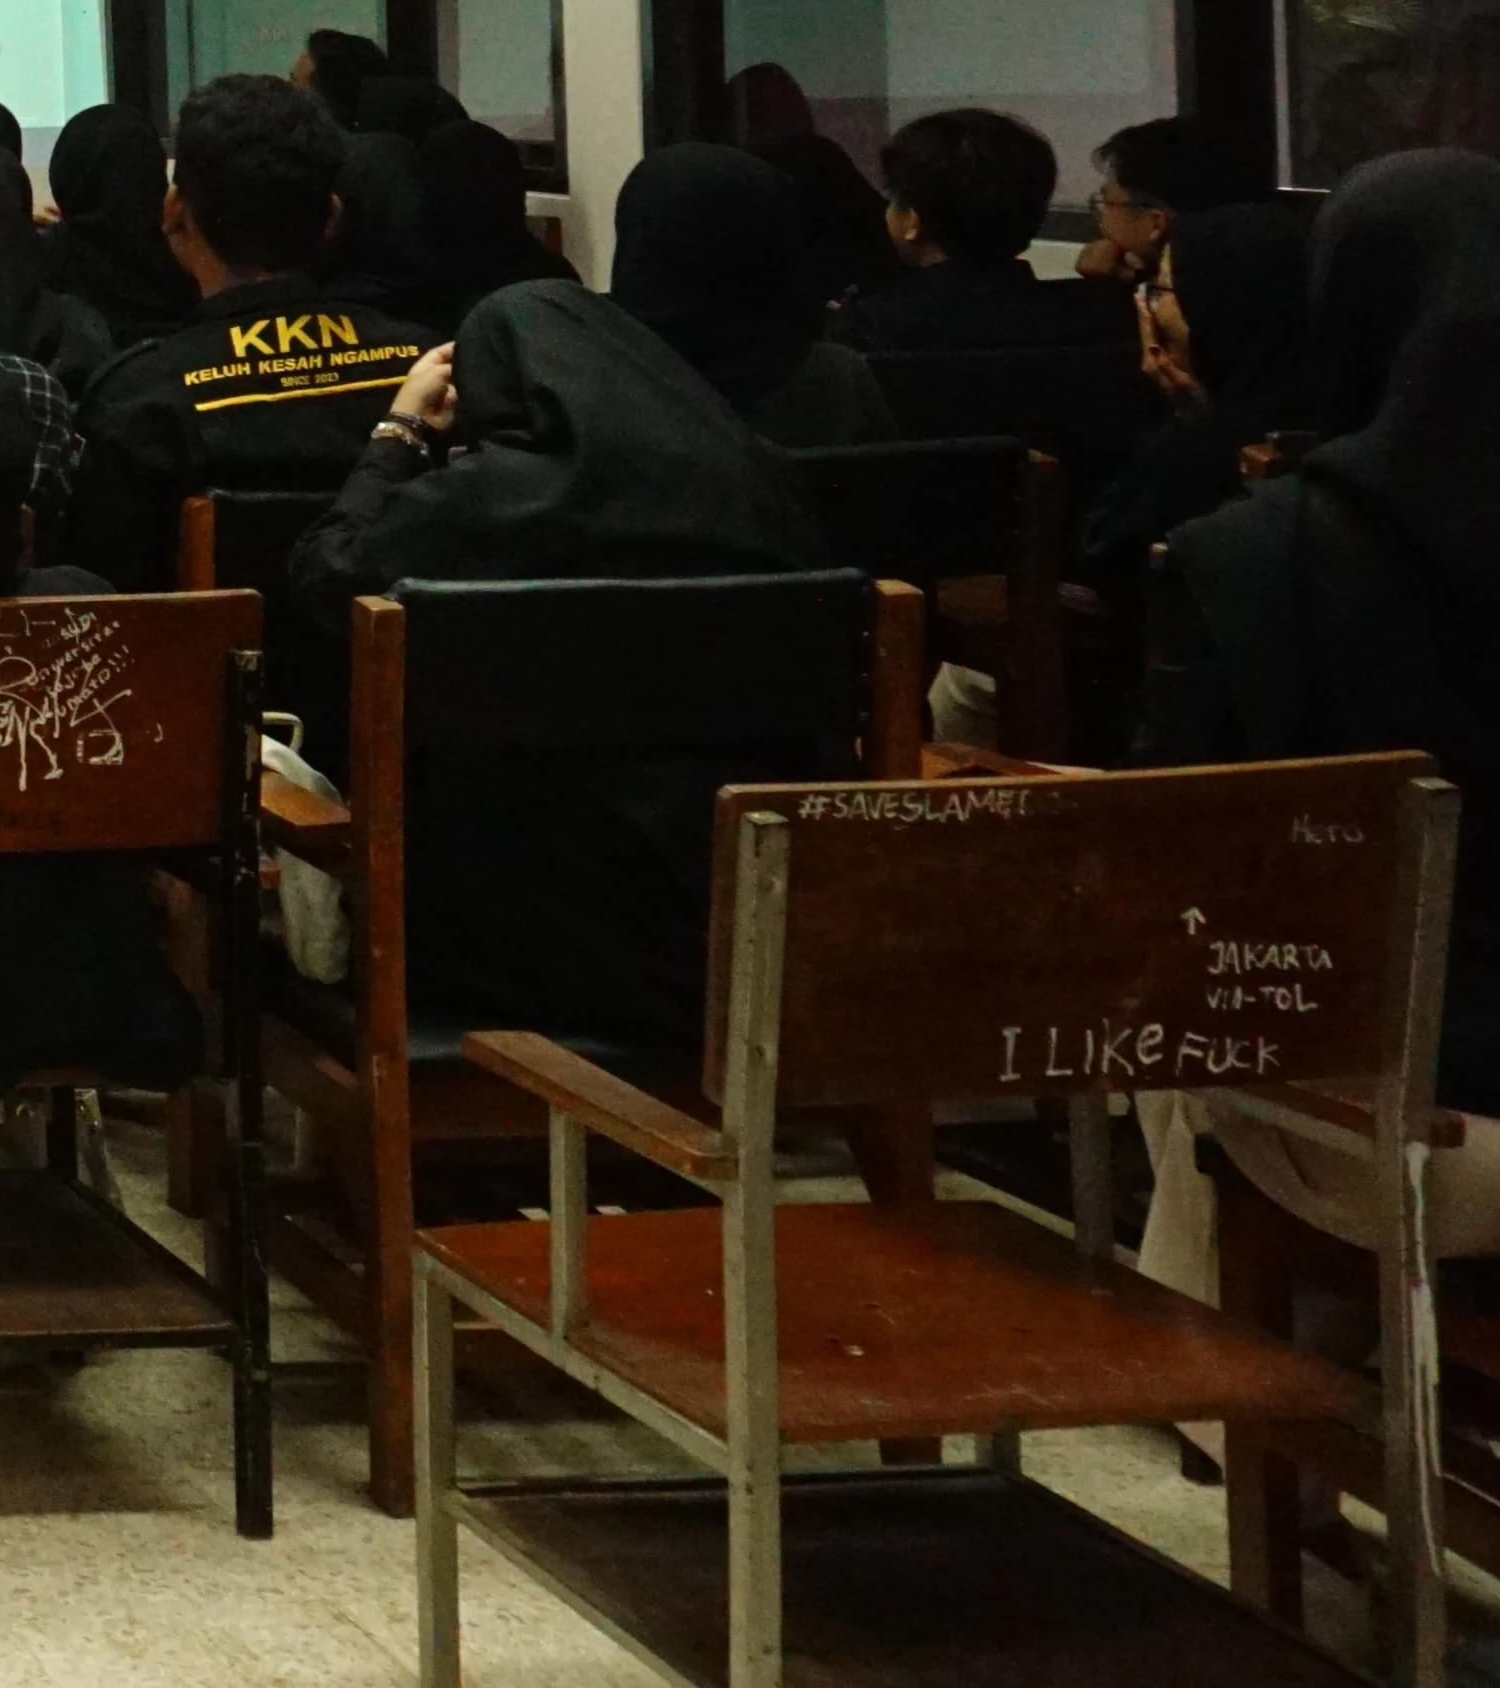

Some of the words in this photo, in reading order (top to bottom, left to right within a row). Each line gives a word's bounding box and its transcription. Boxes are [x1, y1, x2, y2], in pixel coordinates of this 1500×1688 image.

[228, 313, 359, 358] KKN
[184, 362, 251, 387] KELUH
[258, 354, 323, 375] KESAH
[330, 344, 420, 367] NGAMPUS
[280, 375, 311, 388] SINCE
[1000, 1026, 1022, 1082] I
